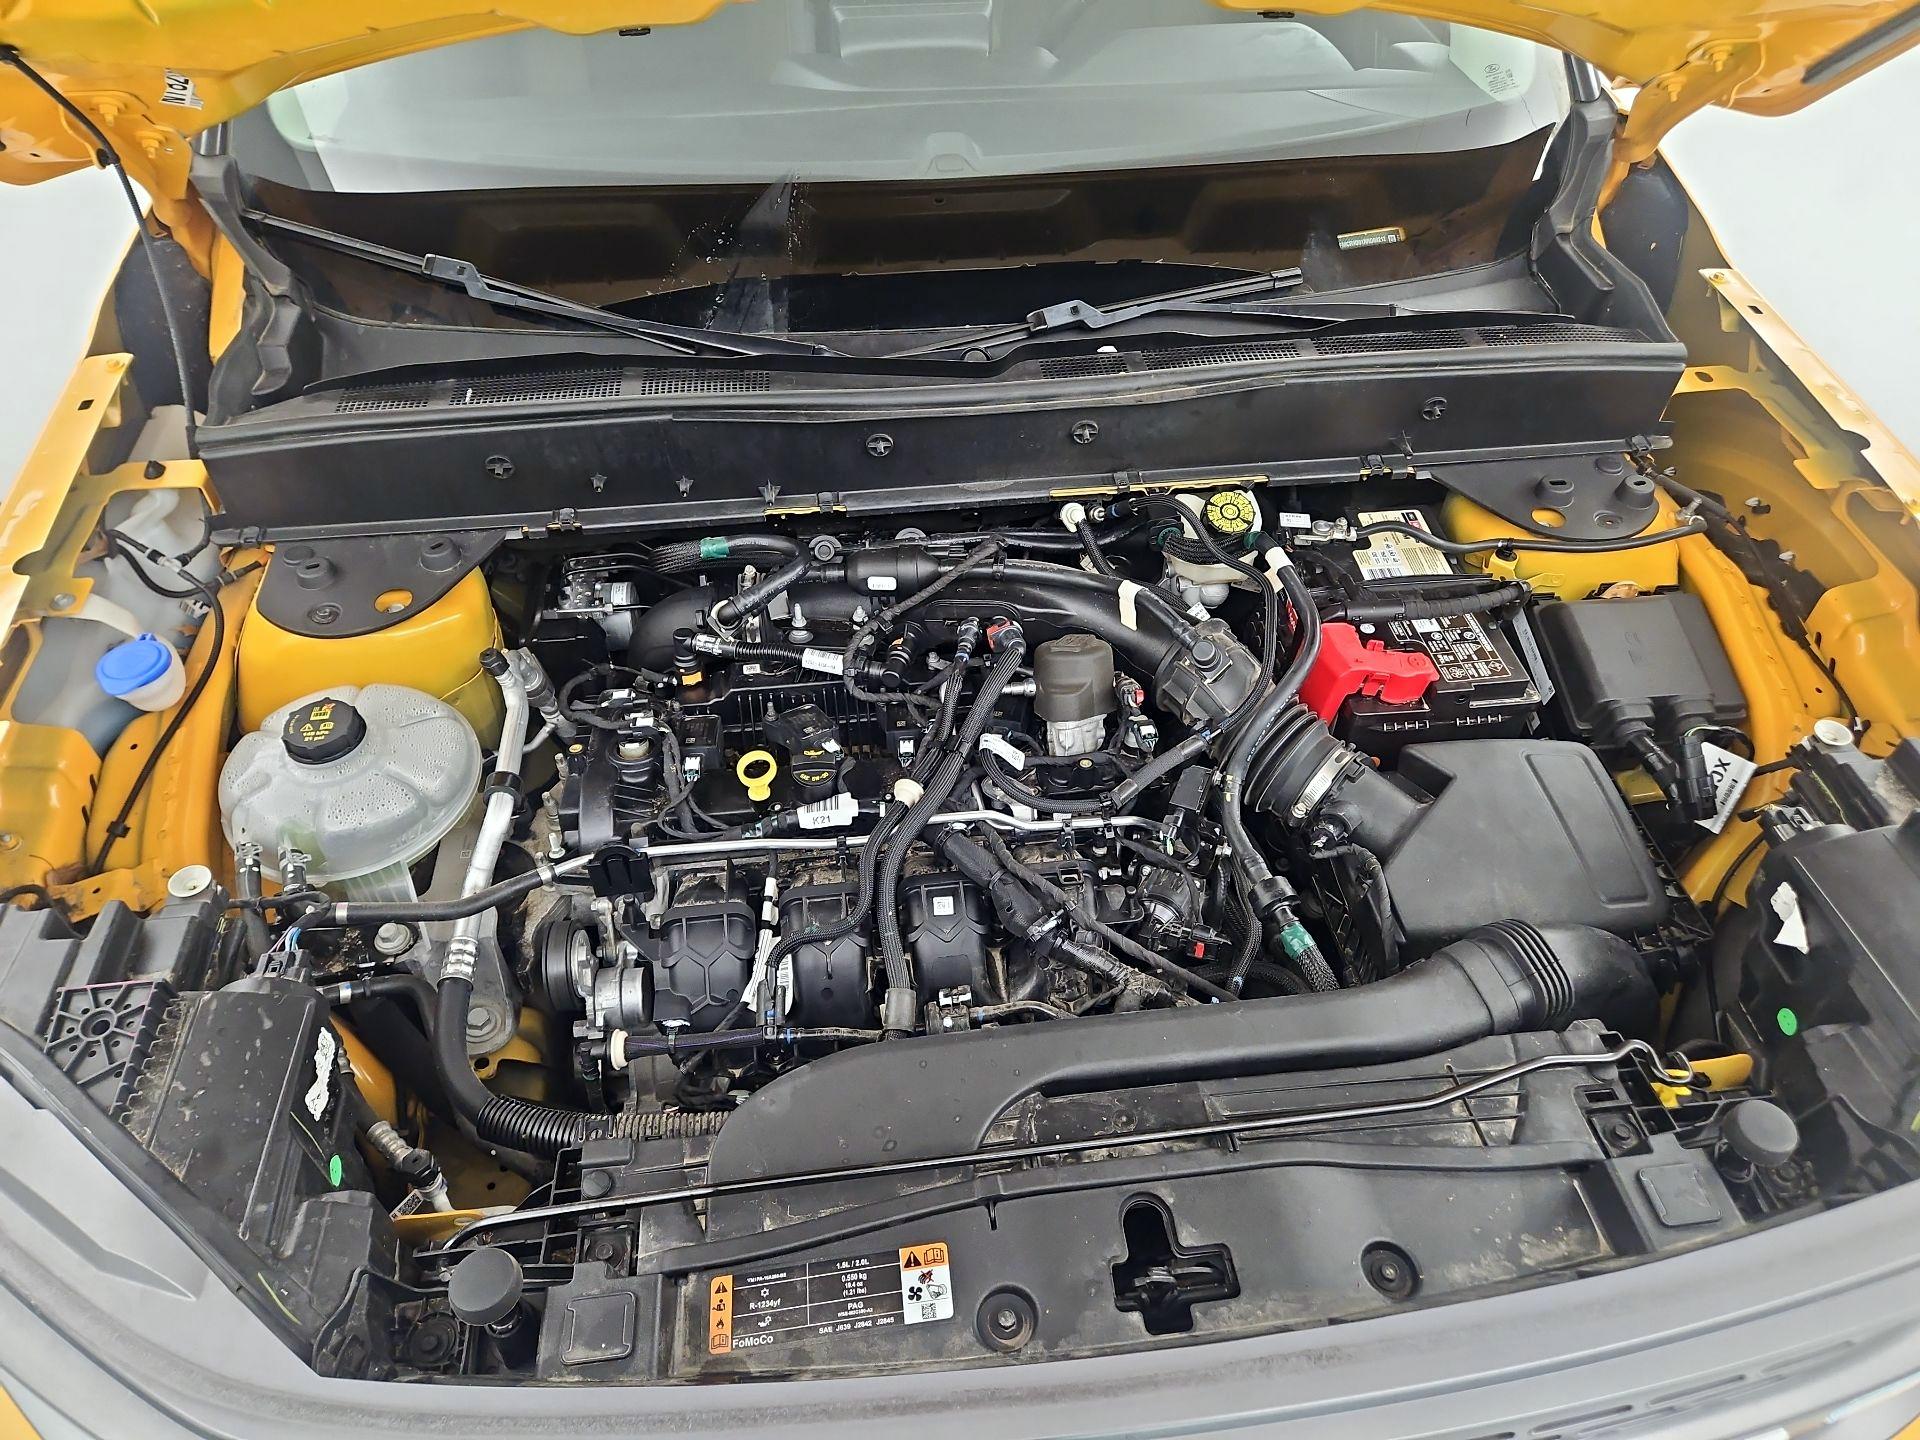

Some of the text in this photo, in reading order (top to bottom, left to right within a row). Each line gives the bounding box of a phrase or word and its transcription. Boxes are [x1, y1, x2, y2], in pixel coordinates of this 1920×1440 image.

[813, 815, 831, 825] K21
[841, 1272, 867, 1282] 0.550 kg
[845, 1281, 856, 1289] 19.4
[749, 1298, 781, 1310] R-1234yf
[847, 1301, 864, 1310] PAG
[818, 1326, 833, 1334] SAE
[732, 1335, 774, 1348] FoMoCo
